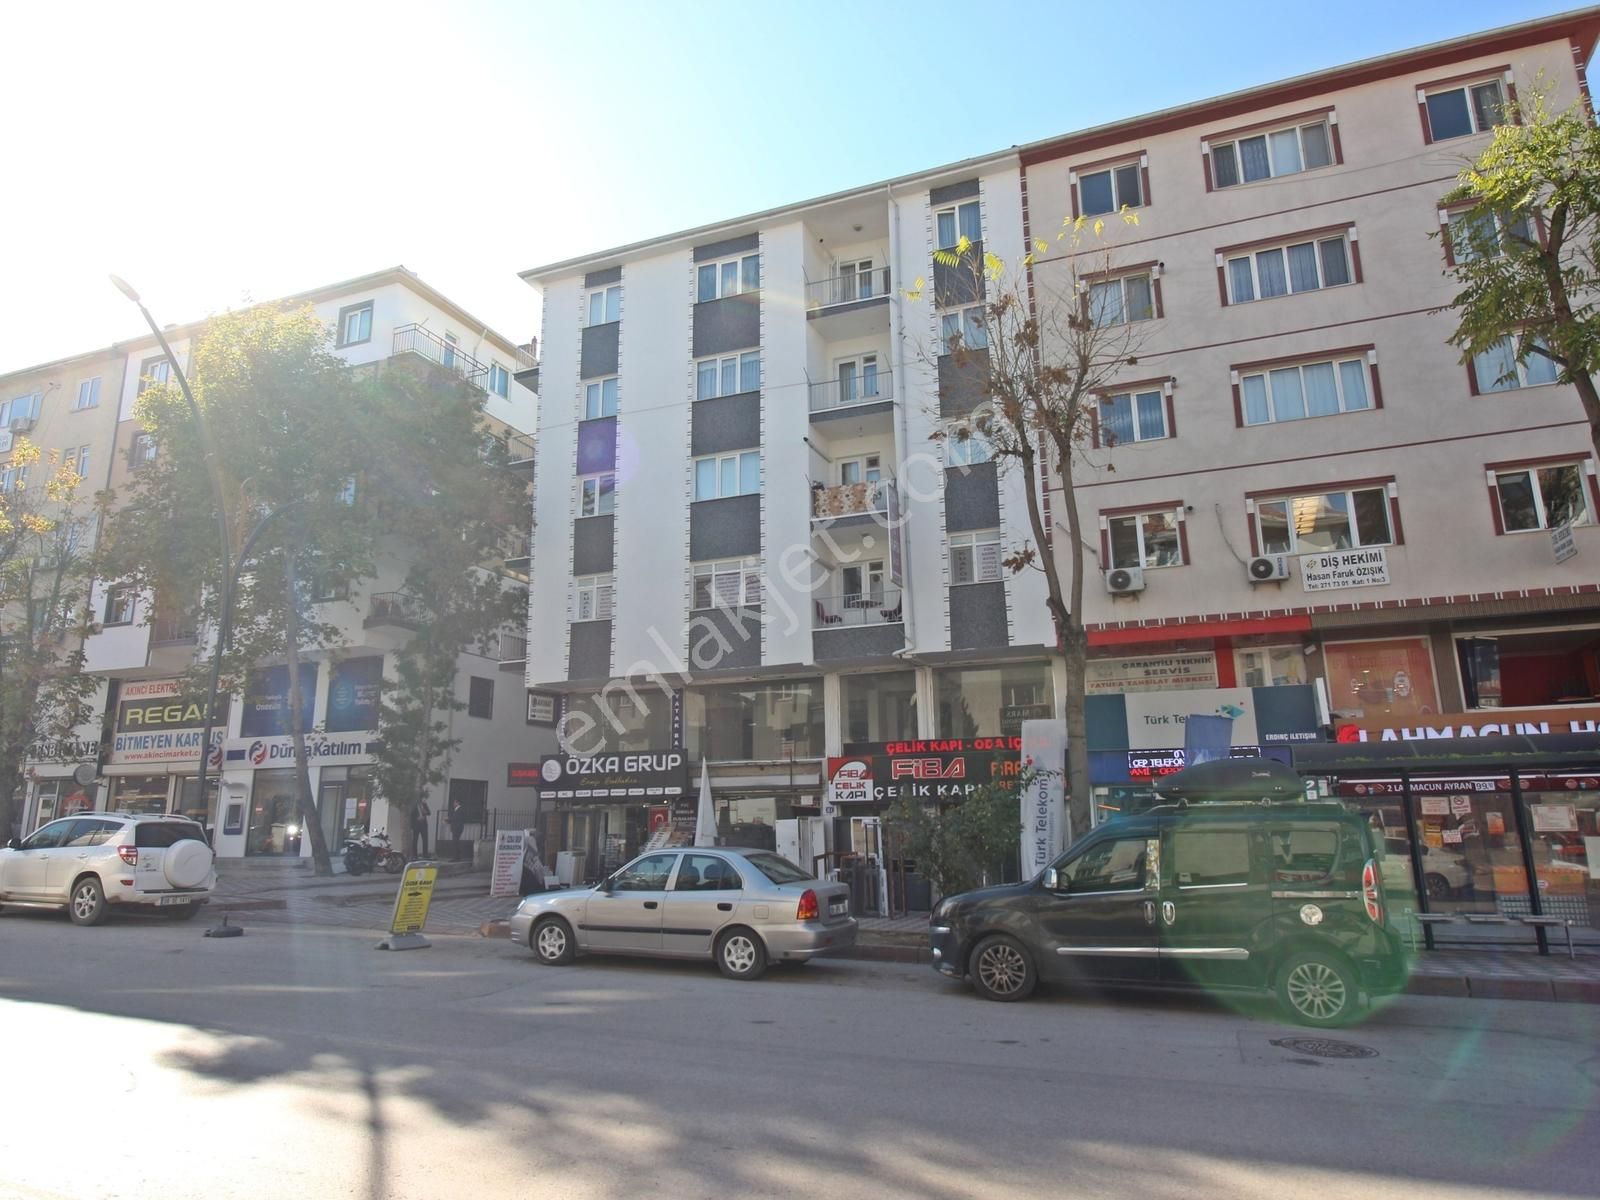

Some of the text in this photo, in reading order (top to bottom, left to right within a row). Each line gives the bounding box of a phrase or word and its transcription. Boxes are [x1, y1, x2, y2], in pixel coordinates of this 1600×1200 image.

[1321, 551, 1382, 569] DİŞ HEKİMİ
[1306, 565, 1384, 582] Hasan Faruk ÖZIŞIK
[1175, 656, 1212, 665] TEKNİK
[1143, 667, 1191, 676] SERVİS
[1144, 714, 1169, 725] Türk
[115, 733, 173, 752] BİTMEYEN
[886, 740, 926, 755] ÇELİK
[930, 739, 963, 752] KAPI
[124, 749, 201, 761] www.akincimarket.c
[269, 742, 361, 759] Düna Katılım
[565, 753, 681, 775] ÖZKA GRUP
[1132, 758, 1147, 768] CEP
[937, 783, 982, 797] KAP
[1387, 784, 1393, 792] 2
[1394, 783, 1442, 792] LAMACUN
[1444, 782, 1473, 791] AYRAN
[835, 790, 867, 800] KAPI
[1034, 778, 1048, 867] Türk Telekom
